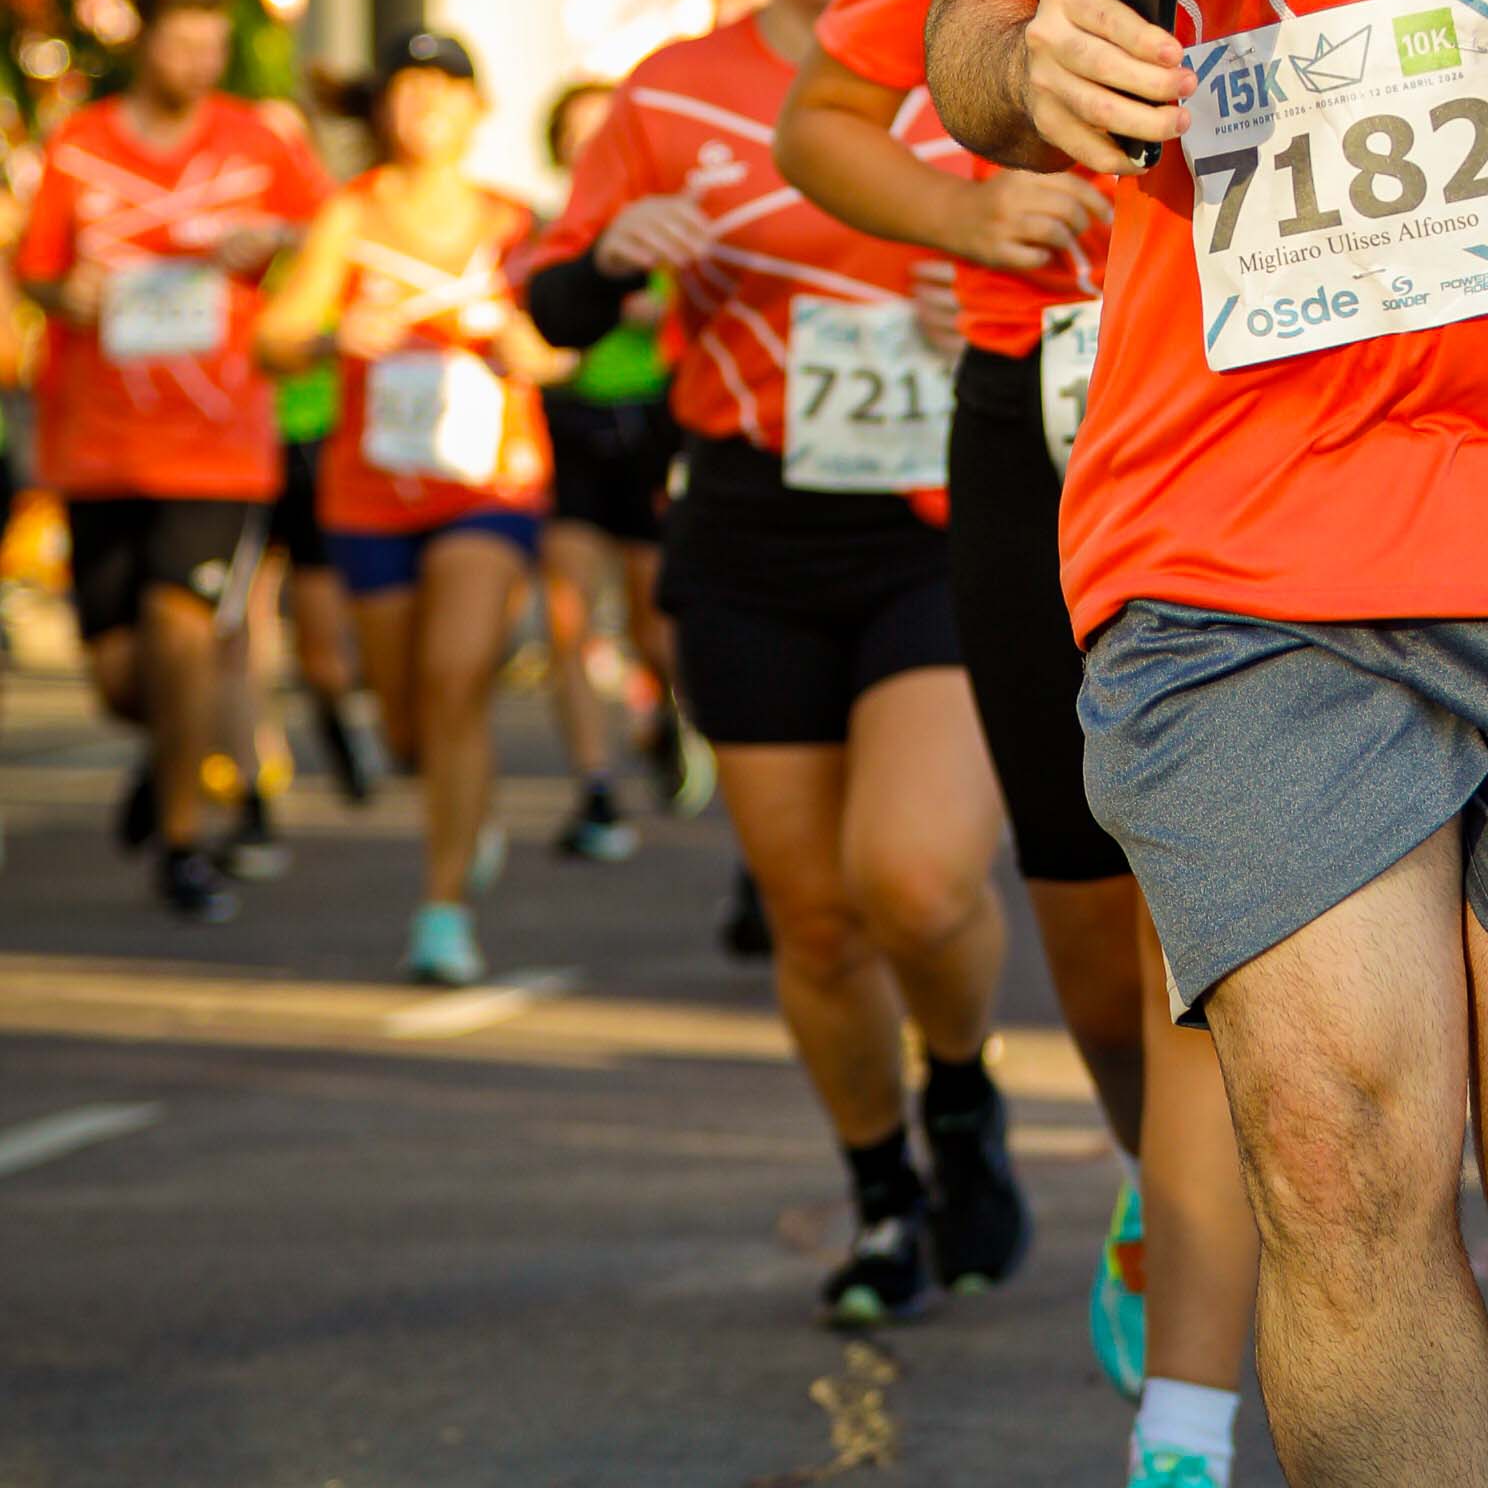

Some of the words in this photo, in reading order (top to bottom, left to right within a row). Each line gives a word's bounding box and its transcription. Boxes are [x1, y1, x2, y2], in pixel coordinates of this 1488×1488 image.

[1402, 27, 1453, 59] 10K
[1210, 58, 1289, 119] 15K
[1214, 119, 1250, 136] PUERTO
[1252, 112, 1281, 127] NORTE
[1315, 93, 1357, 109] ROSARIO
[1368, 88, 1381, 97] 12
[1385, 84, 1399, 95] DE
[1402, 77, 1434, 91] ABRIL
[1438, 71, 1465, 84] 2026
[1239, 244, 1322, 275] Migliaro
[1327, 228, 1392, 255] Ulises
[1399, 213, 1480, 242] Alfonso
[1246, 285, 1360, 339] osde
